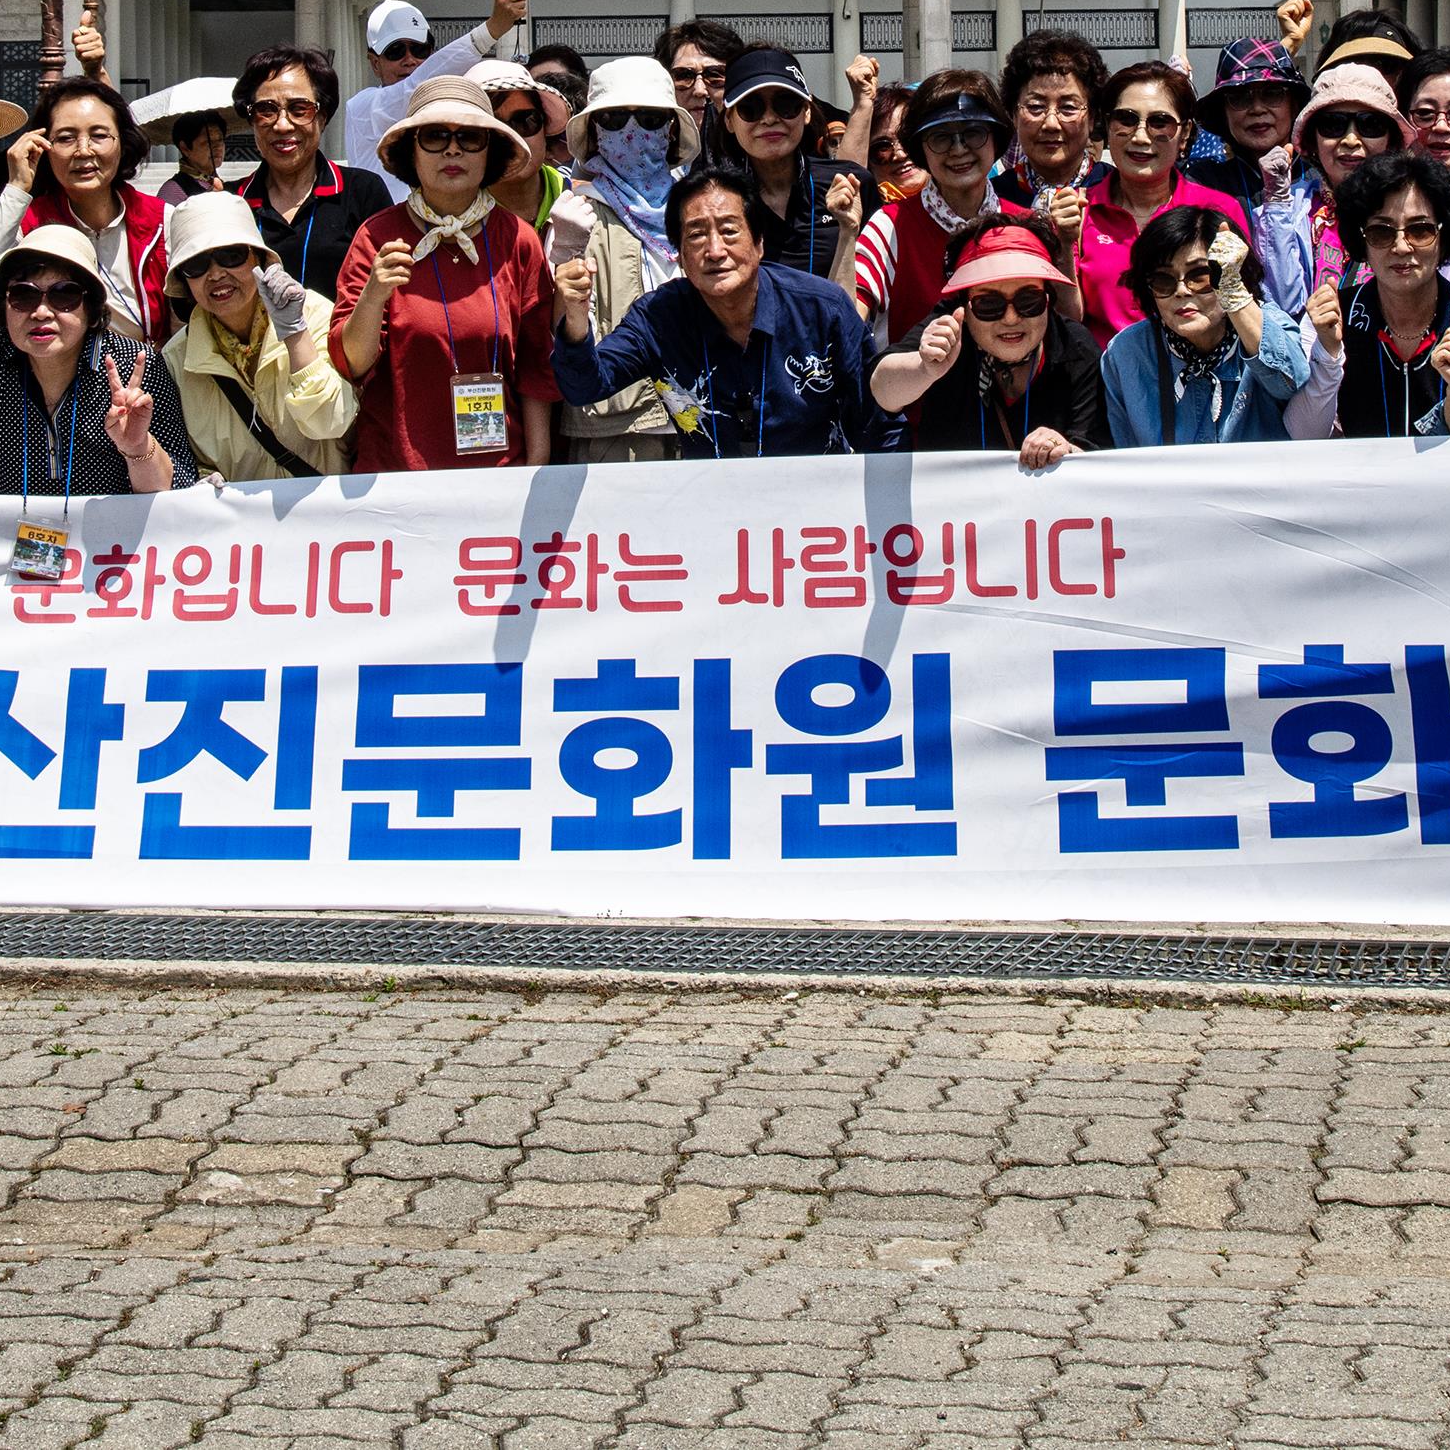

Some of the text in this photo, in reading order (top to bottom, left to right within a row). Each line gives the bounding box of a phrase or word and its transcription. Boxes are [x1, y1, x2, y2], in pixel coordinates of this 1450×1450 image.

[467, 401, 492, 412] 1호차
[10, 539, 405, 624] 문화입니다
[452, 531, 690, 616] 문화는
[716, 516, 1128, 610] 사람입니다
